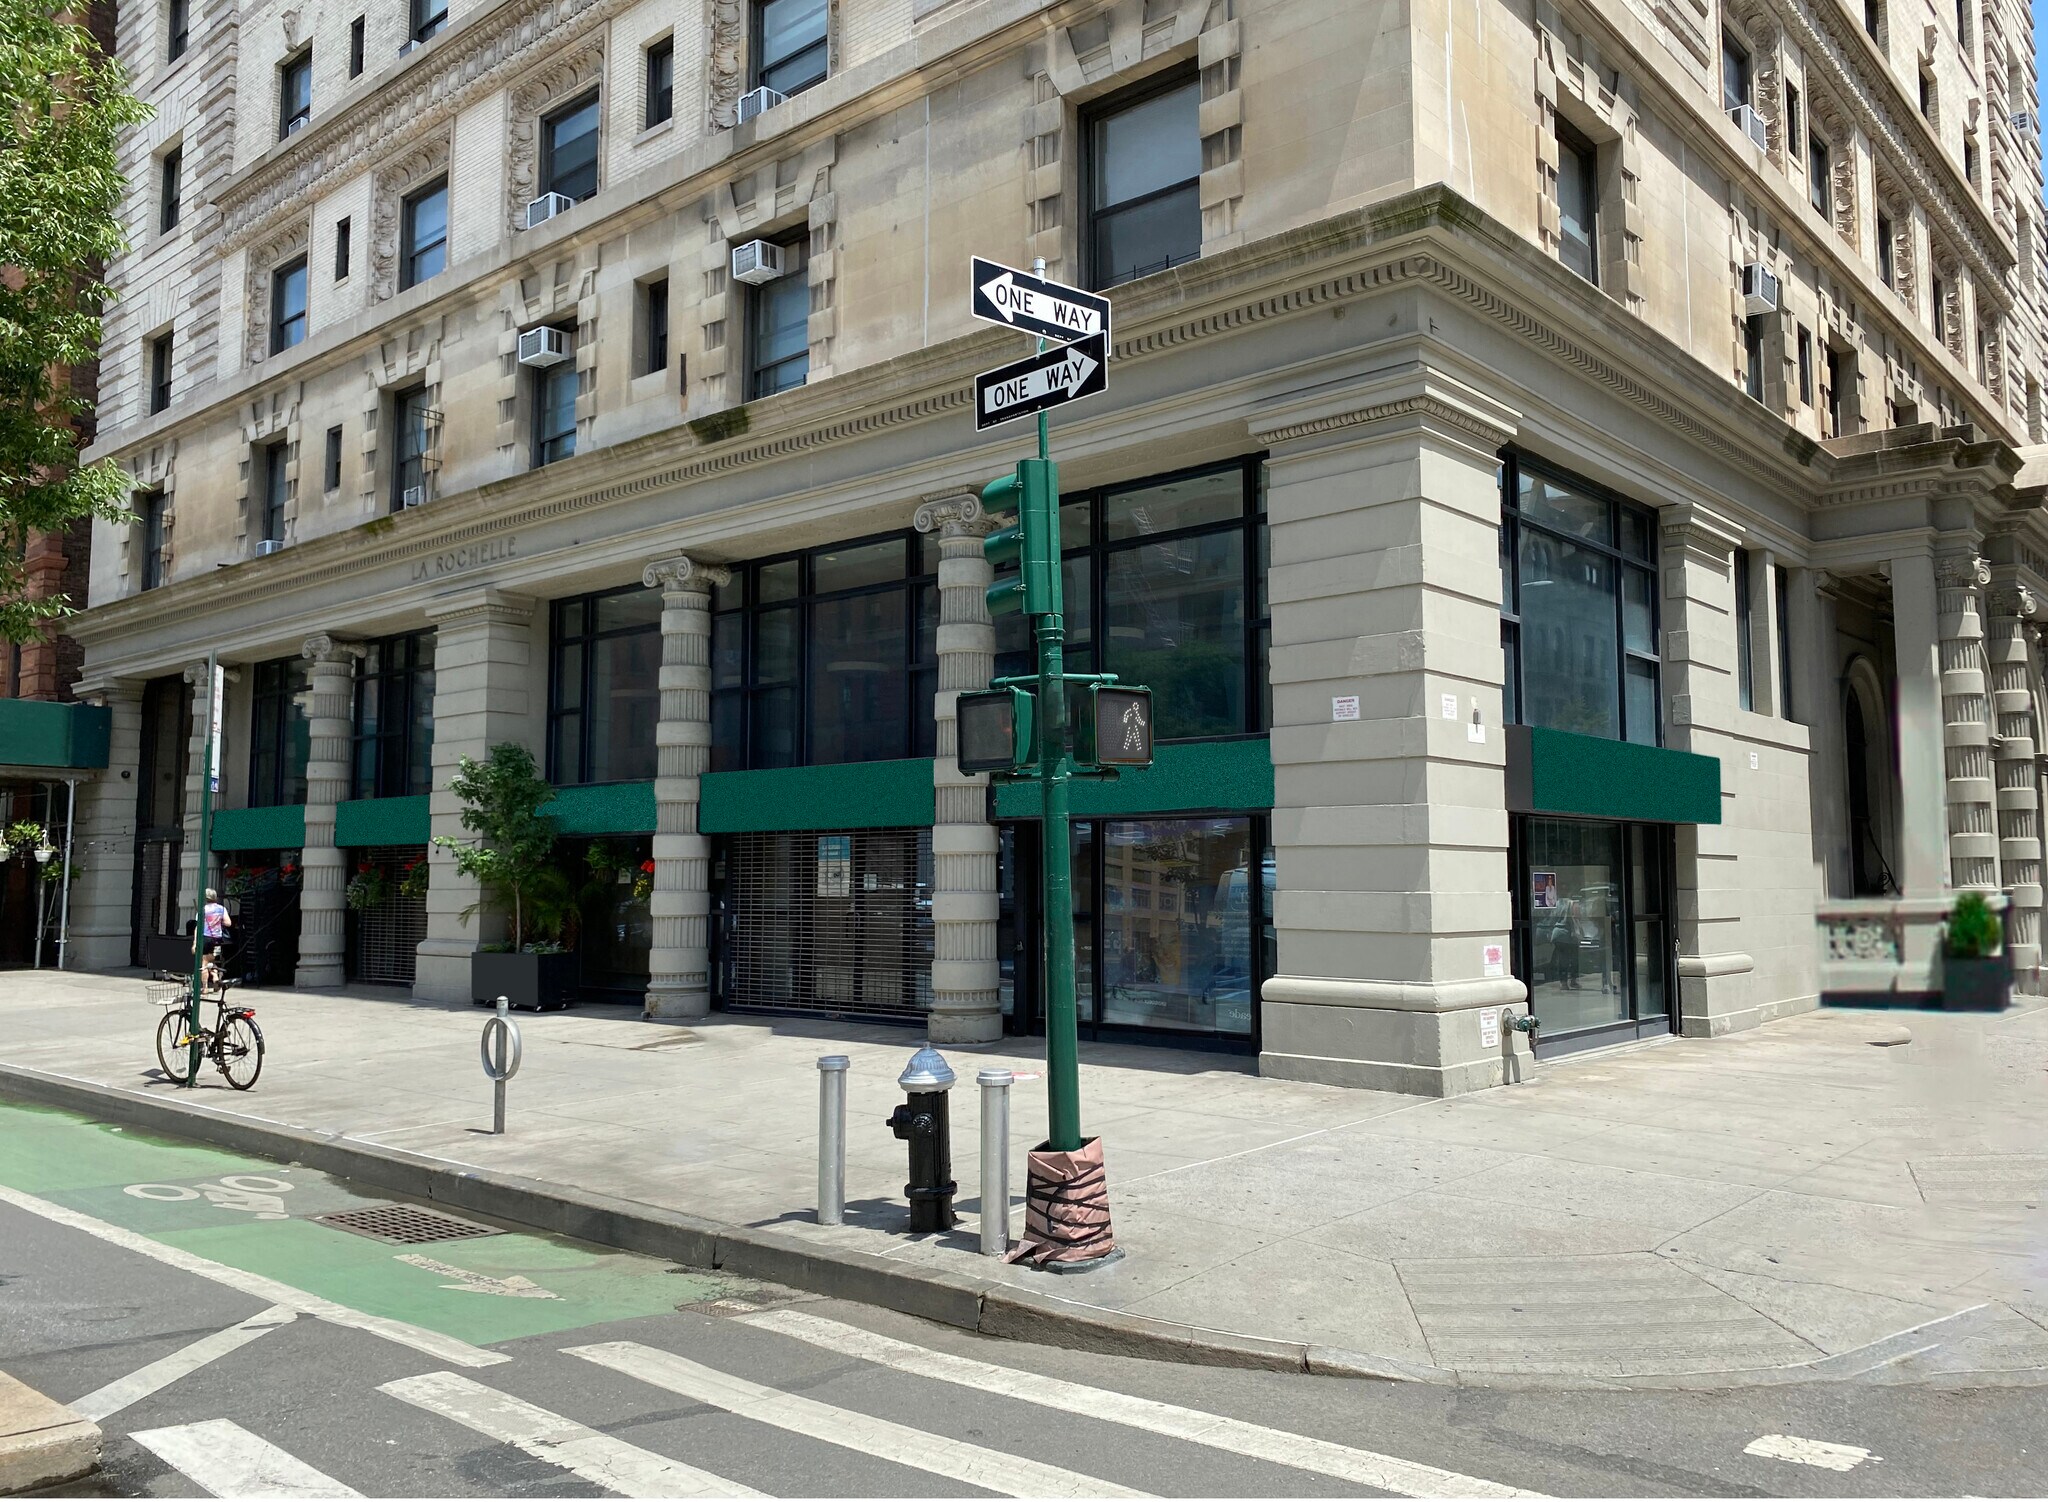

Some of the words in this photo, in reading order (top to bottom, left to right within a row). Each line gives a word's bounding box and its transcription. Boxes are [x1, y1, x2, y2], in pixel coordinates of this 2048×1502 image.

[995, 284, 1034, 314] ONE
[1053, 301, 1093, 331] WAY
[994, 377, 1029, 407] ONE
[1046, 357, 1085, 390] WAY
[411, 561, 428, 581] LA
[436, 536, 517, 574] ROCHELLE
